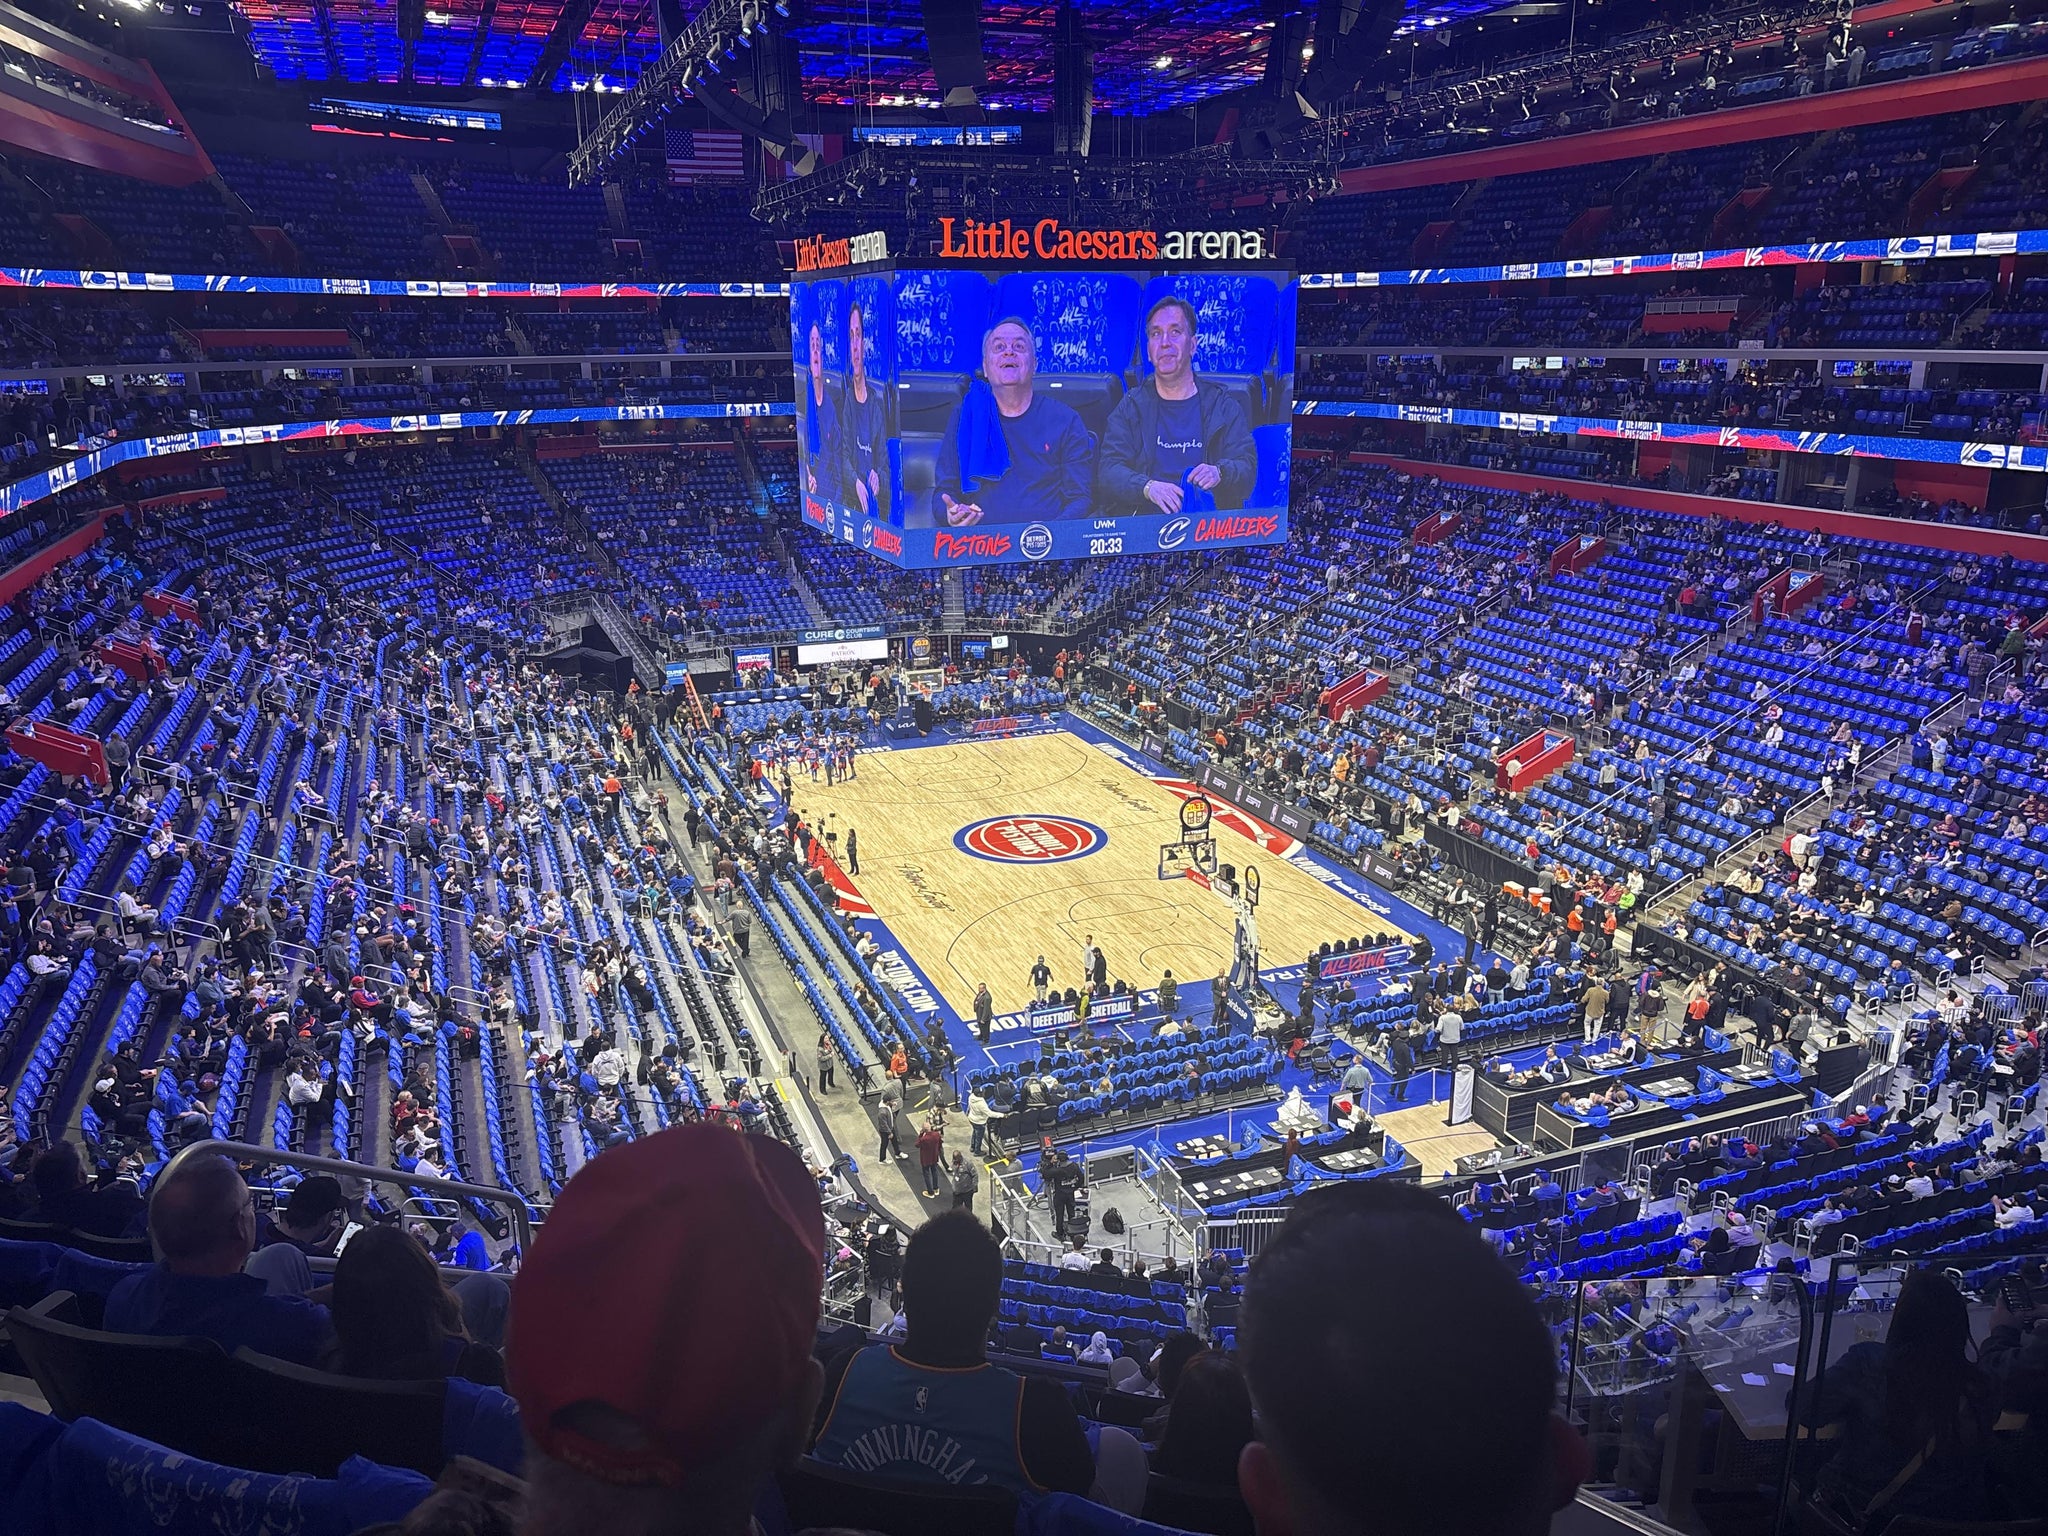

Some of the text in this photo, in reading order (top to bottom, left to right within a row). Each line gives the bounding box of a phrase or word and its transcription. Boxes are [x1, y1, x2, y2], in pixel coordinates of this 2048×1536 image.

[939, 217, 1263, 260] Little Caesars arena
[1888, 232, 2018, 259] CLE
[793, 231, 886, 272] Little Caesars arena
[1744, 247, 1764, 267] VS.
[1565, 256, 1642, 277] DET
[80, 270, 174, 291] CLE
[406, 280, 497, 296] DET
[601, 283, 620, 297] VS.
[719, 283, 790, 297] CL
[1299, 272, 1379, 288] CLE
[1059, 307, 1084, 324] ALL
[1053, 340, 1088, 358] DAWG
[325, 419, 343, 436] VS.
[391, 412, 462, 432] CLE
[1499, 411, 1557, 432] DET
[220, 424, 284, 446] DET
[1719, 427, 1741, 447] VS.
[1961, 442, 2048, 473] CL
[48, 461, 78, 493] CLE
[1093, 519, 1116, 530] UWM
[1194, 514, 1279, 542] CAVALIERS
[933, 530, 1011, 561] PISTONS
[1090, 537, 1123, 555] 20:33
[804, 631, 834, 640] CURE
[1013, 728, 1067, 738] ULTRA
[1212, 777, 1227, 790] ESPN
[1245, 794, 1262, 809] ESPN
[1281, 814, 1299, 829] ESPN
[994, 824, 1046, 855] PISTONS
[1018, 822, 1069, 851] DETROIT
[1374, 864, 1393, 880] ESPN
[1321, 959, 1349, 976] ALL
[1349, 950, 1387, 971] DAWG
[1033, 1000, 1132, 1029] DEEETROI SKETBALL
[840, 1424, 988, 1485] UNNINGHA
